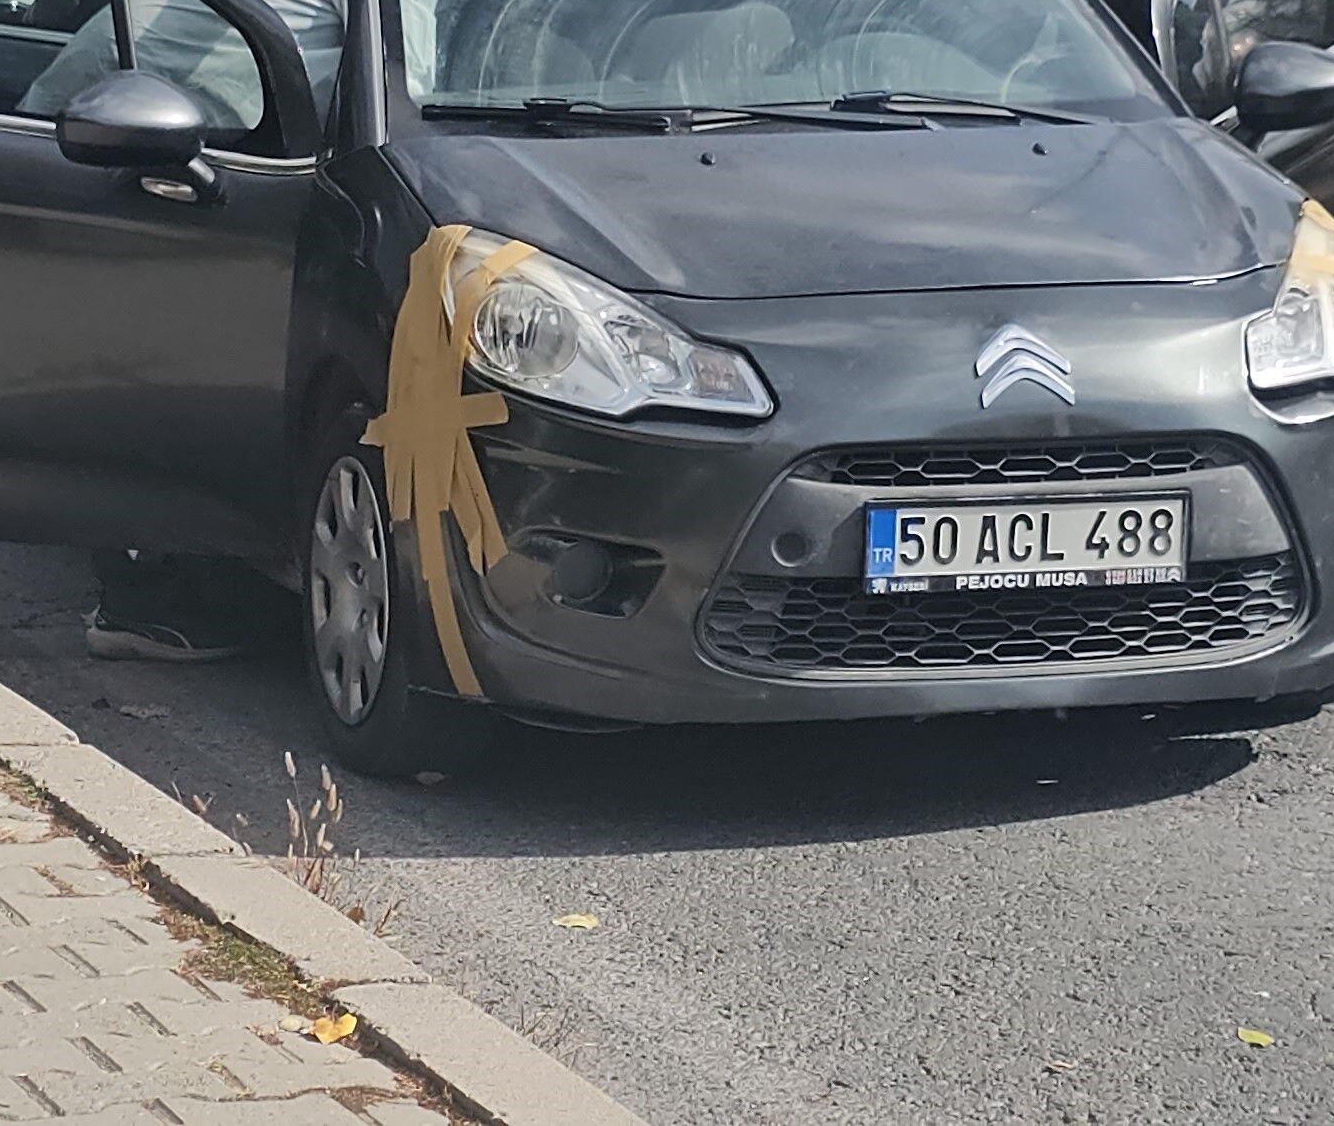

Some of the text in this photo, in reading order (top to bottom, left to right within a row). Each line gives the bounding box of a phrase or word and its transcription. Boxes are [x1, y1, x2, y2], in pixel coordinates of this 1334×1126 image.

[873, 508, 1174, 566] TR 50 ACL 488
[955, 573, 1030, 590] PEJOCU
[1035, 571, 1088, 587] MUSA
